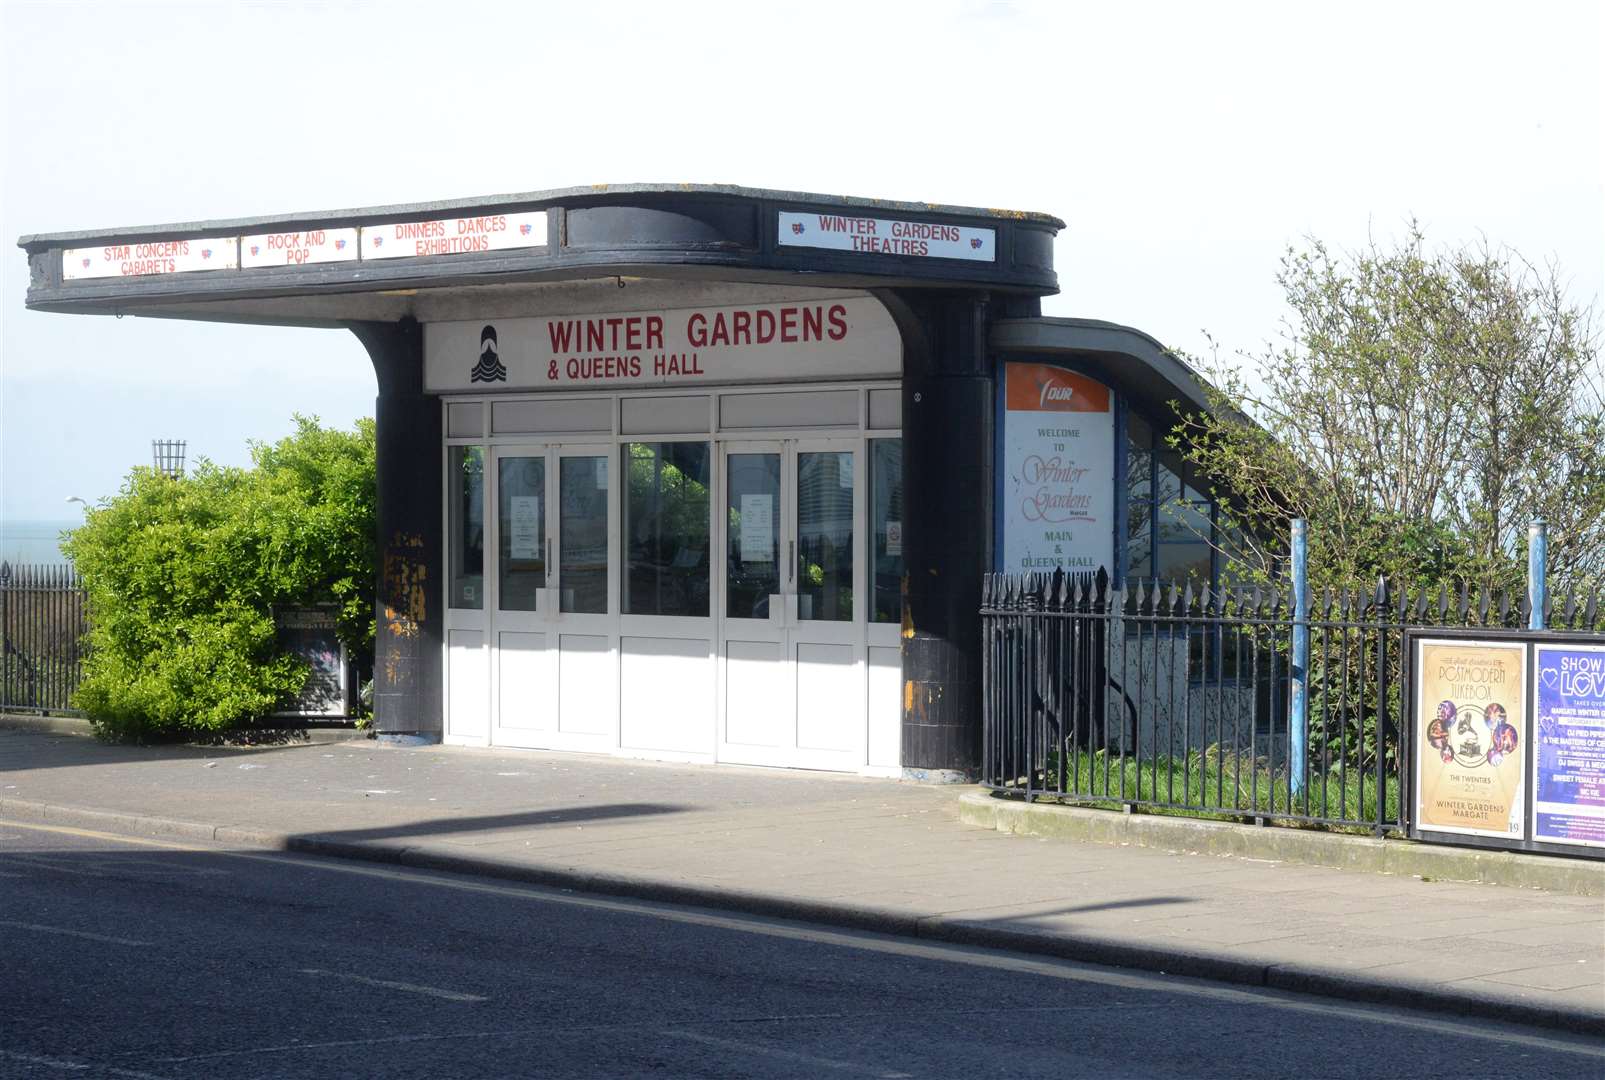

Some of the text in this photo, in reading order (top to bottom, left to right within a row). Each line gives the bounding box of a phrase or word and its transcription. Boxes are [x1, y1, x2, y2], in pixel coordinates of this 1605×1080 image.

[395, 216, 507, 240] DINNERS DANCES
[819, 216, 960, 242] WINTER GARDENS
[267, 231, 326, 249] ROCK AND
[416, 235, 489, 256] EXHIBITIONS
[850, 235, 929, 256] THEATRES
[104, 240, 190, 261] STAR CONCERTS
[287, 250, 310, 264] POP
[121, 259, 176, 275] CABARETS
[548, 304, 848, 353] WINTER GARDENS
[547, 353, 704, 380] & QUEENS HALL
[1038, 428, 1081, 438] WELCOME
[1054, 443, 1065, 452] TO
[1022, 455, 1091, 485] Winter
[1022, 486, 1095, 523] Gardens
[1044, 531, 1073, 542] MAIN
[1054, 545, 1063, 554] &
[1021, 557, 1096, 568] QUEENS HALL
[1560, 656, 1602, 672] SHOW
[1439, 665, 1506, 684] POSTMODERN
[1451, 683, 1492, 701] JUKEBOX
[1449, 774, 1492, 785] THE TWENTIES
[1436, 800, 1505, 814] WINTER GARDENS
[1452, 809, 1489, 821] MARGATE
